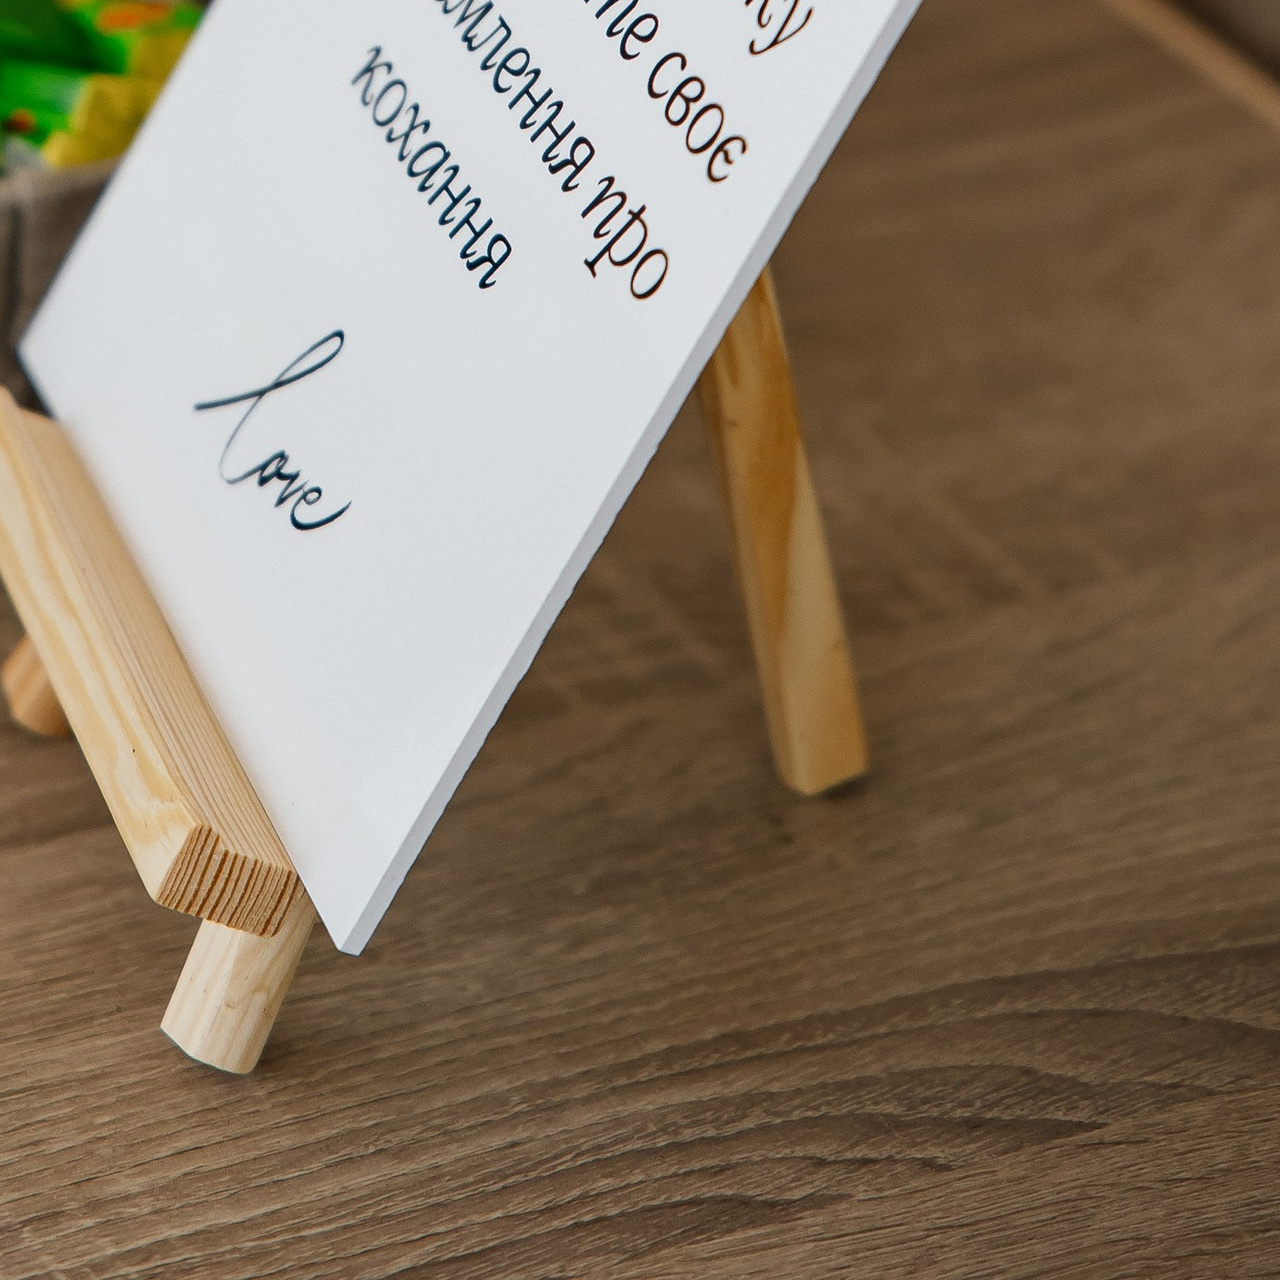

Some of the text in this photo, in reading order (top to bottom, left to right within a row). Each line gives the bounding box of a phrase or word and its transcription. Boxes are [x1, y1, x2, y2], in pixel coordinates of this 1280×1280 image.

[350, 46, 513, 291] кохання
[647, 51, 748, 184] своє
[581, 173, 670, 302] про
